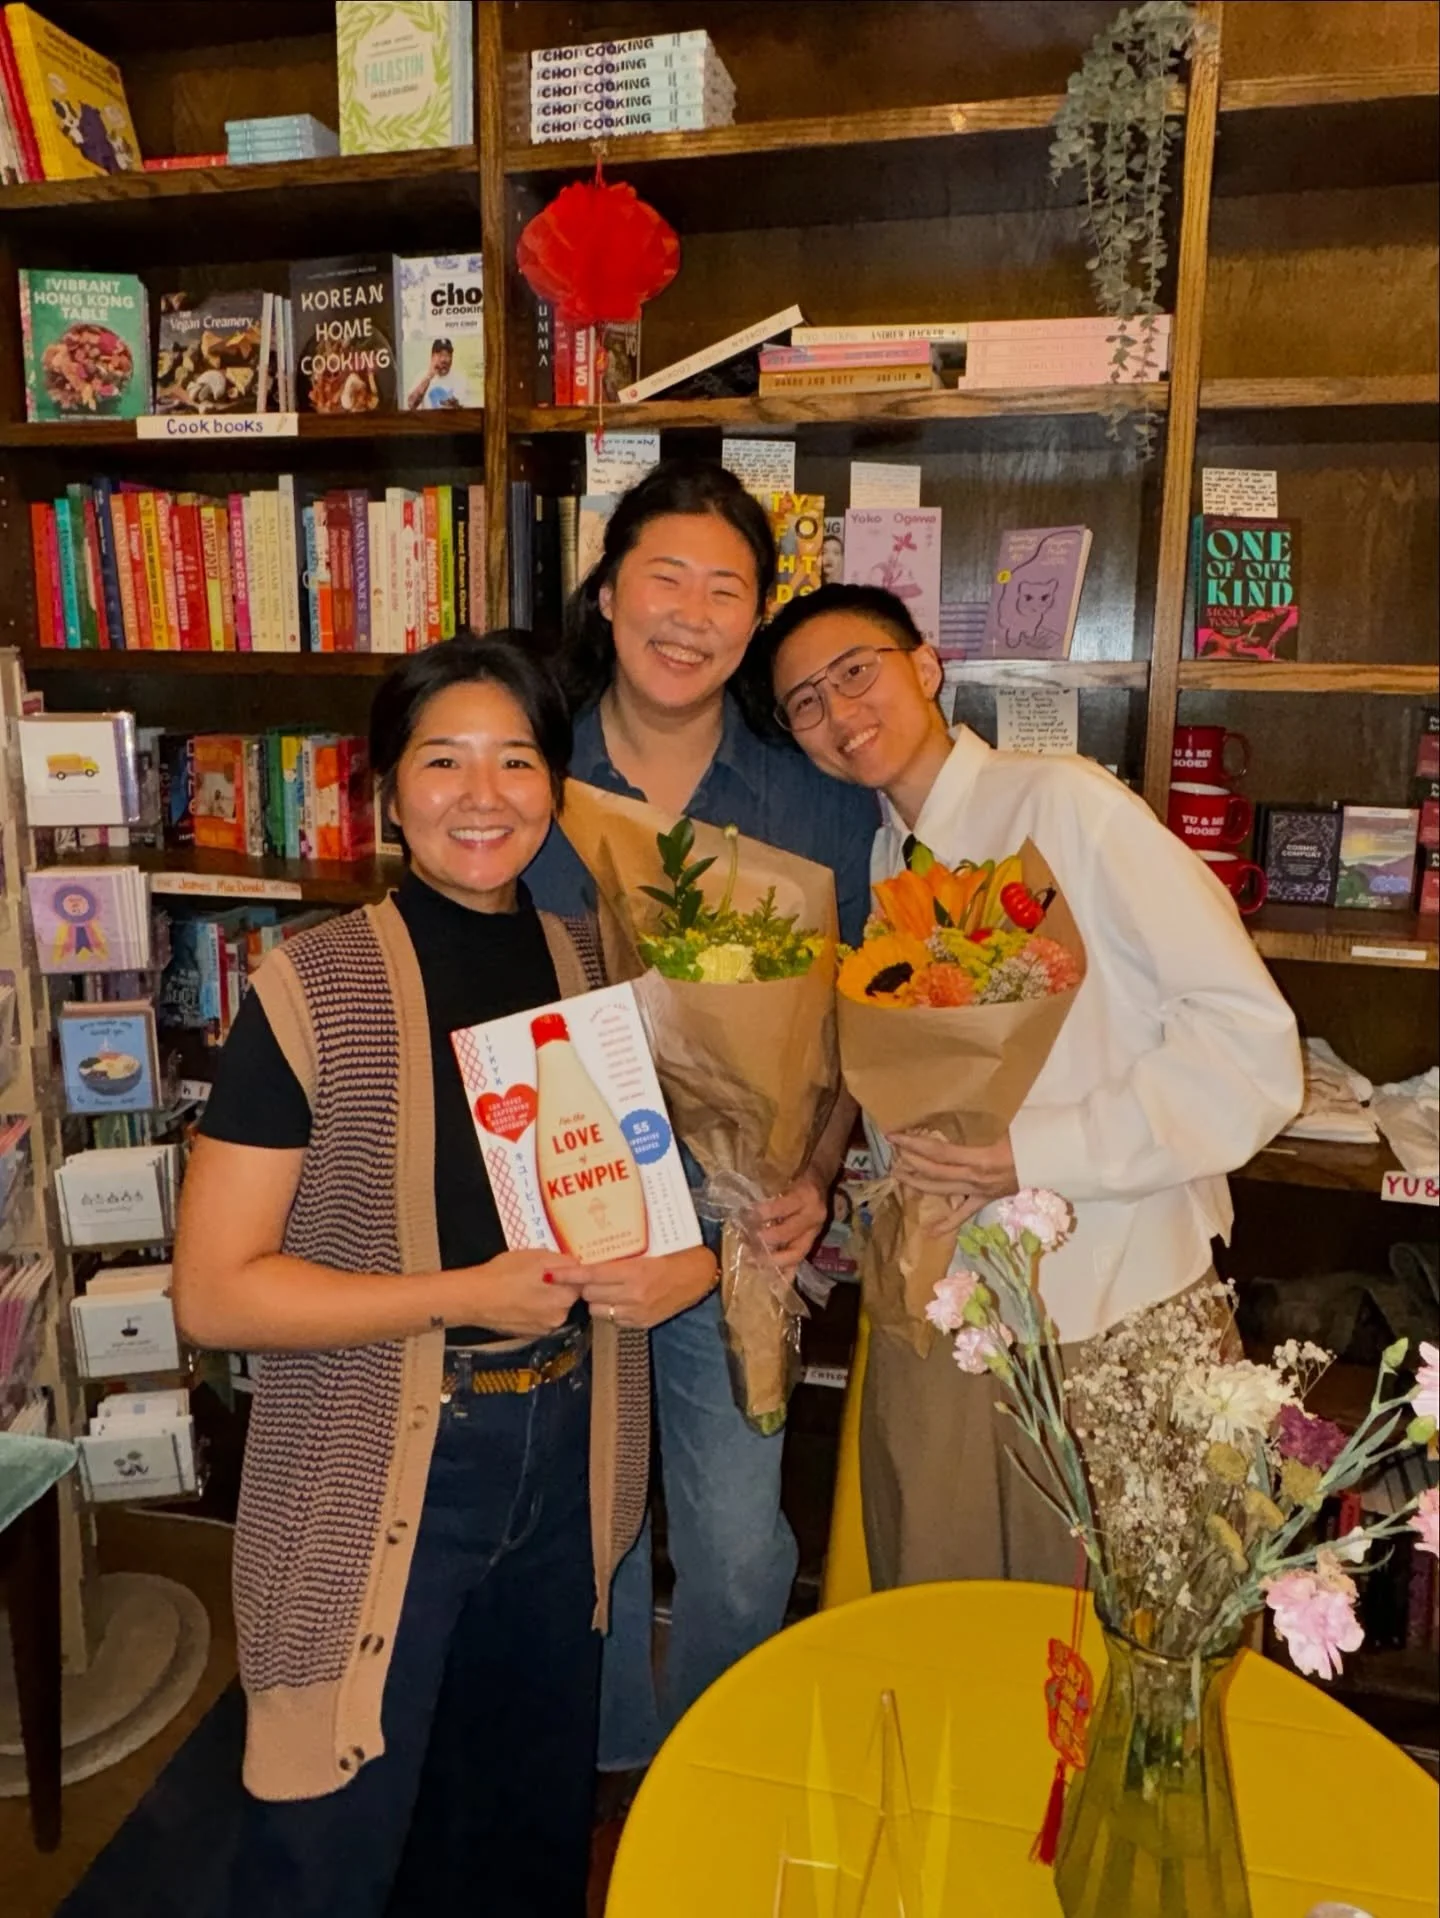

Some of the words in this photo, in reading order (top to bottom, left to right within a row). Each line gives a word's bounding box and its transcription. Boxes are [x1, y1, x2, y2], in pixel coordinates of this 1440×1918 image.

[585, 37, 654, 58] COOKING
[584, 77, 650, 94] COOKING
[584, 95, 652, 112] COOKING
[584, 113, 651, 130] COOKING
[51, 278, 120, 294] VIBRANT
[34, 291, 83, 307] HONG
[87, 293, 135, 310] KONG
[301, 283, 384, 312] KOREAN
[62, 306, 109, 321] TABLE
[431, 307, 444, 317] OF
[170, 317, 200, 333] Vegan
[203, 314, 254, 331] Creamery
[315, 317, 372, 342] HOME
[301, 348, 391, 375] COOKING
[850, 513, 882, 525] Yoko
[893, 512, 937, 526] Ogawa
[1207, 529, 1292, 562] ONE
[426, 538, 438, 602] Madame
[1206, 561, 1235, 578] OF
[1245, 562, 1292, 580] OUR
[1207, 579, 1294, 608] KIND
[1185, 749, 1194, 759] &
[1182, 814, 1199, 826] YU
[1201, 816, 1210, 827] &
[632, 1119, 651, 1135] 55
[552, 1123, 604, 1155] LOVE
[547, 1158, 630, 1200] KEWPIE
[1386, 1175, 1420, 1197] YU
[1425, 1177, 1439, 1198] &
